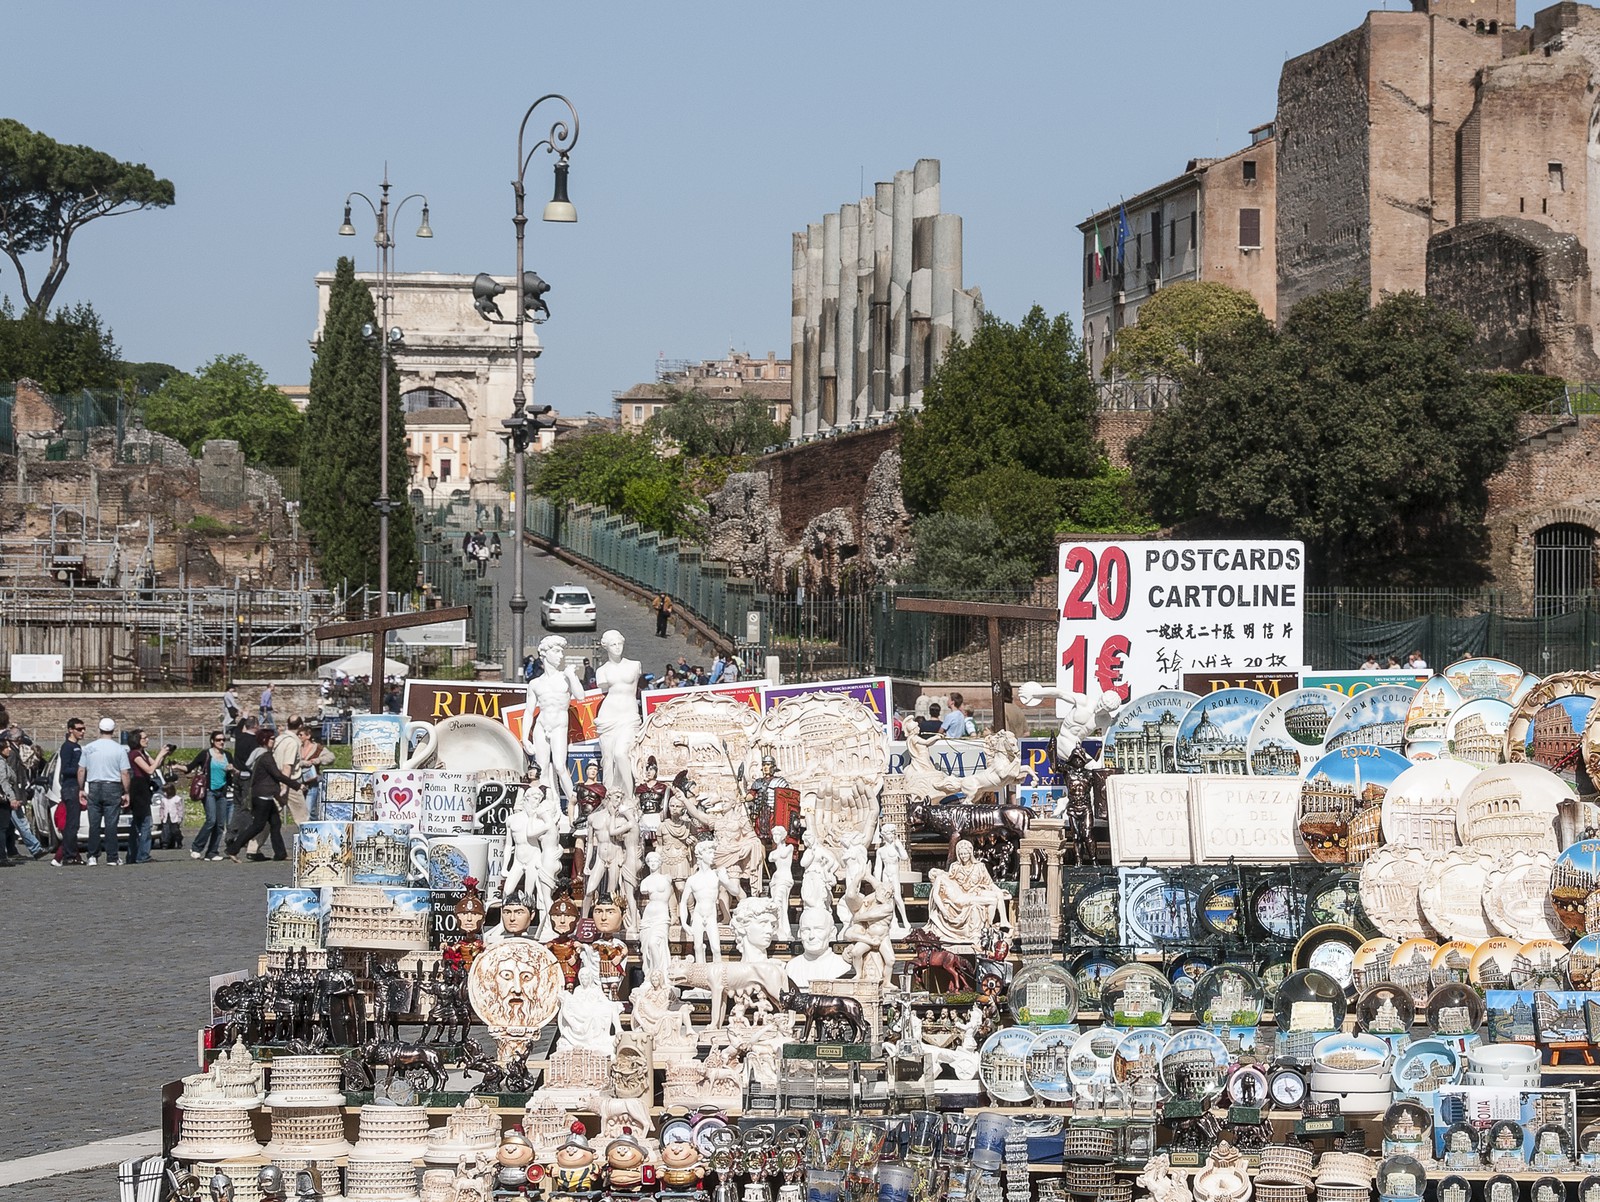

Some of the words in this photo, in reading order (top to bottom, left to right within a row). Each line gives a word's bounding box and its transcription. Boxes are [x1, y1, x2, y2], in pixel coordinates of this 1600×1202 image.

[1145, 548, 1301, 572] POSTCARDS
[1063, 546, 1132, 621] 20
[1148, 584, 1296, 608] CARTOLINE
[431, 691, 502, 720] RIM
[1212, 696, 1239, 710] ROMA
[1244, 697, 1260, 706] SAN
[1345, 697, 1377, 720] ROMA
[1382, 695, 1414, 704] COLOS
[1119, 706, 1142, 730] ROMA
[1147, 698, 1182, 709] FONTANA
[1260, 706, 1283, 732] ROMA
[1340, 746, 1381, 759] ROMA
[424, 795, 466, 811] ROMA
[1226, 790, 1294, 804] PIAZZA
[427, 813, 456, 823] Rzym
[1250, 811, 1278, 821] DEL
[1418, 945, 1437, 953] ROMA
[1449, 941, 1467, 950] ROMA
[1488, 941, 1508, 949] ROMA
[1532, 941, 1553, 949] ROMA
